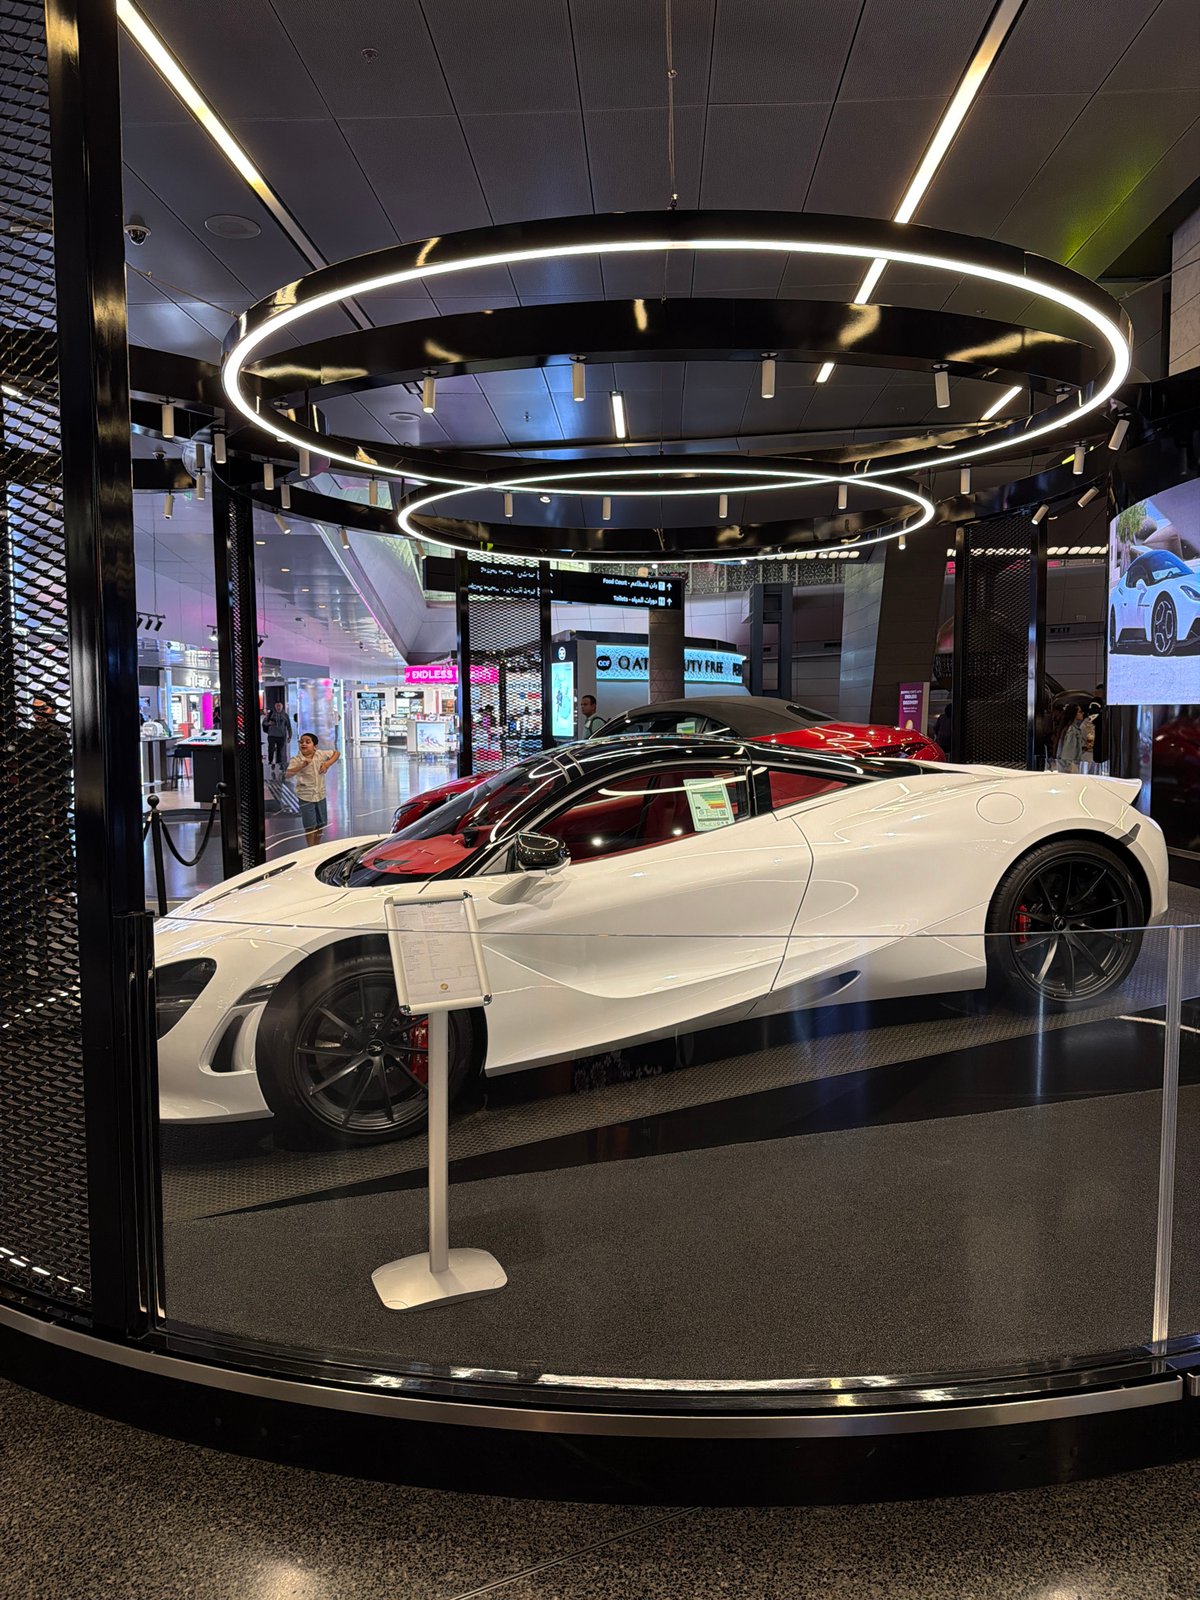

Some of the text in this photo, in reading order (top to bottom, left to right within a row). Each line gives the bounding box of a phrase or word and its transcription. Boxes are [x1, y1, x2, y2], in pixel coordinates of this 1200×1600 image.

[618, 656, 649, 672] QAT
[684, 659, 702, 672] UTY
[705, 660, 724, 674] FREE
